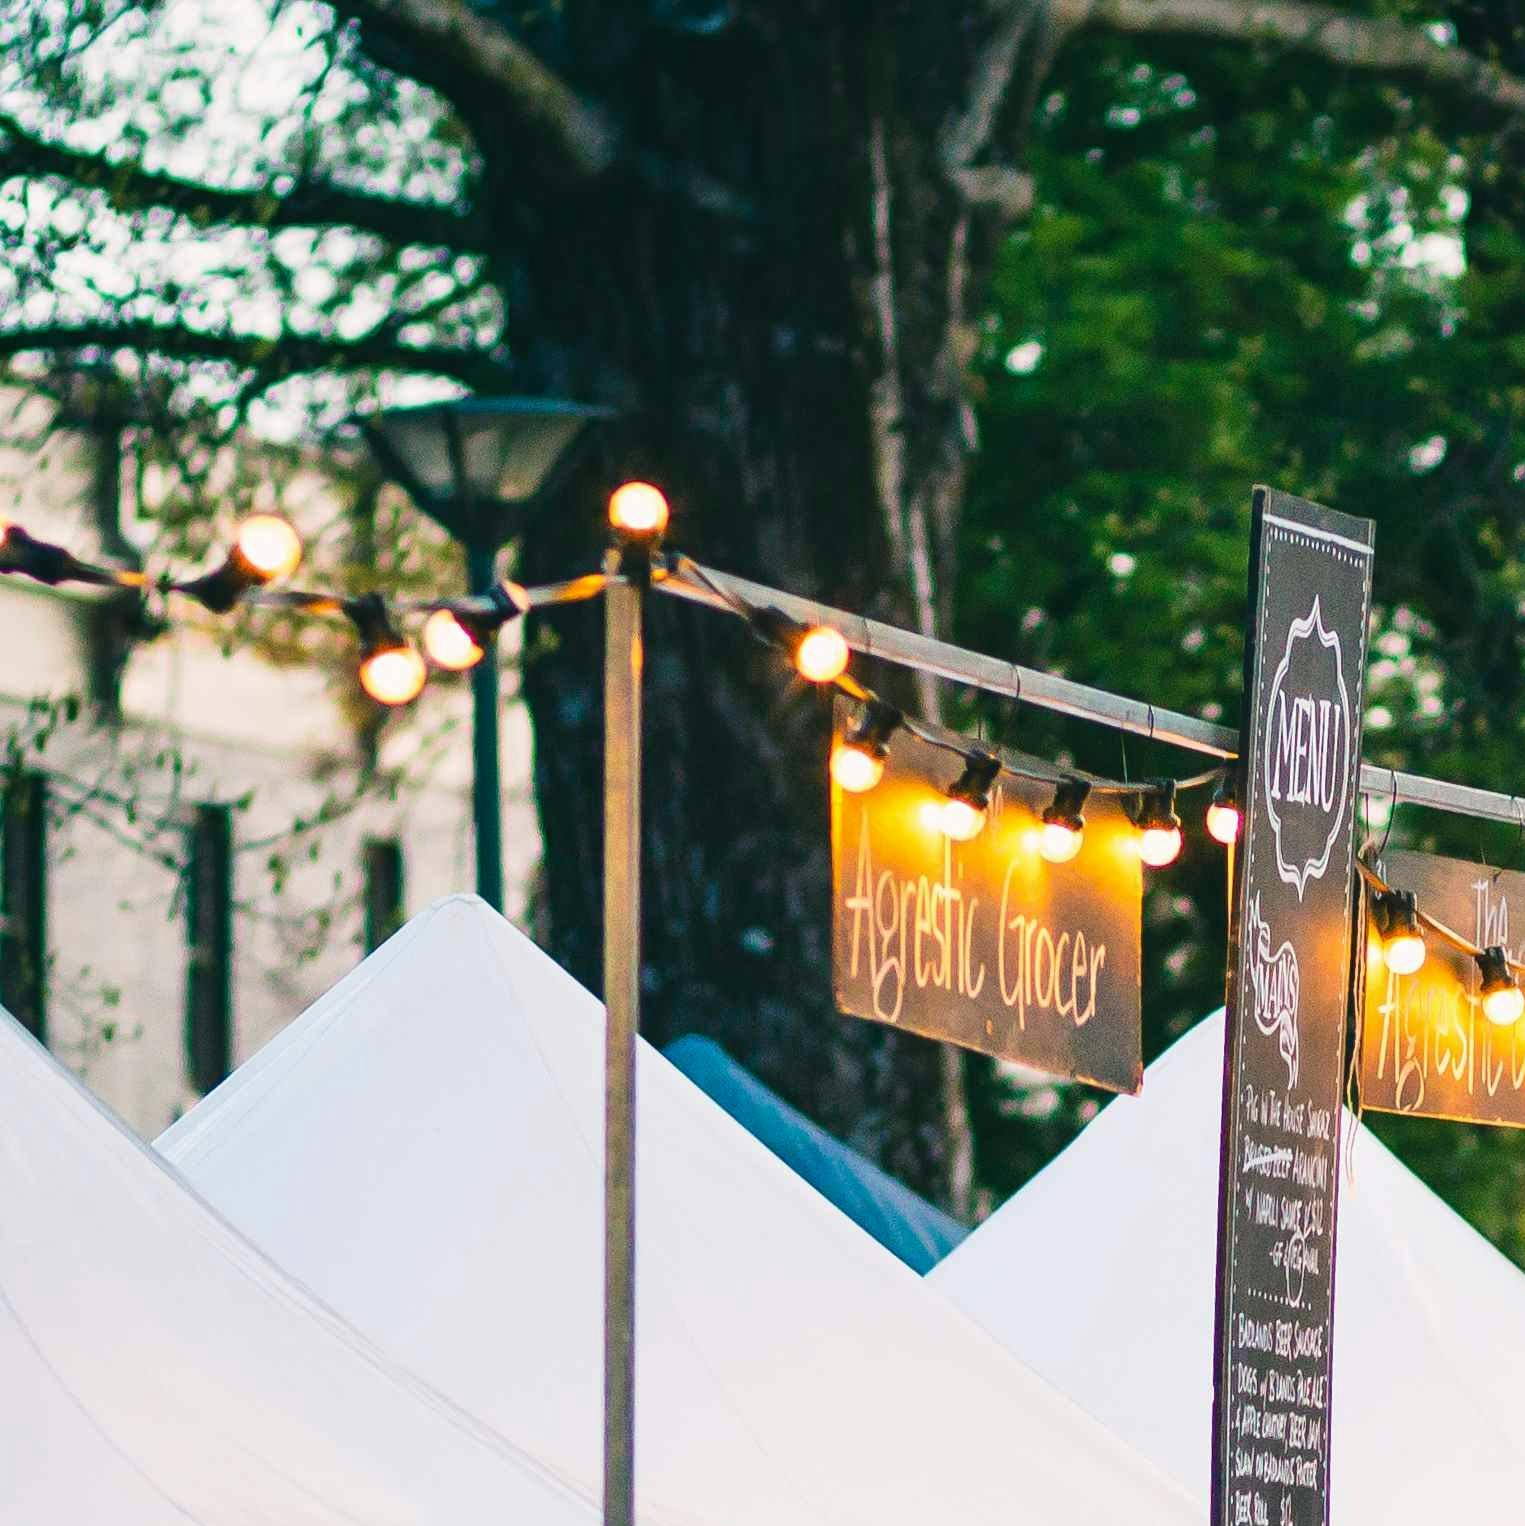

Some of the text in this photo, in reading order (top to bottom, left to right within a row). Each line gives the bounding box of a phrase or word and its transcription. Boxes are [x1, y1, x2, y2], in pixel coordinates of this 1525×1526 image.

[1270, 690, 1341, 812] MENU
[845, 803, 1106, 1031] Agrestic Grocer
[1256, 952, 1297, 1018] MAINS
[1238, 1312, 1273, 1353] BADLANDS
[1275, 1318, 1293, 1362] BEER
[1238, 1362, 1258, 1398] DOGS
[1241, 1406, 1261, 1439] APPLE
[1288, 1411, 1306, 1449] BEER
[1254, 1491, 1269, 1526] ROLL
